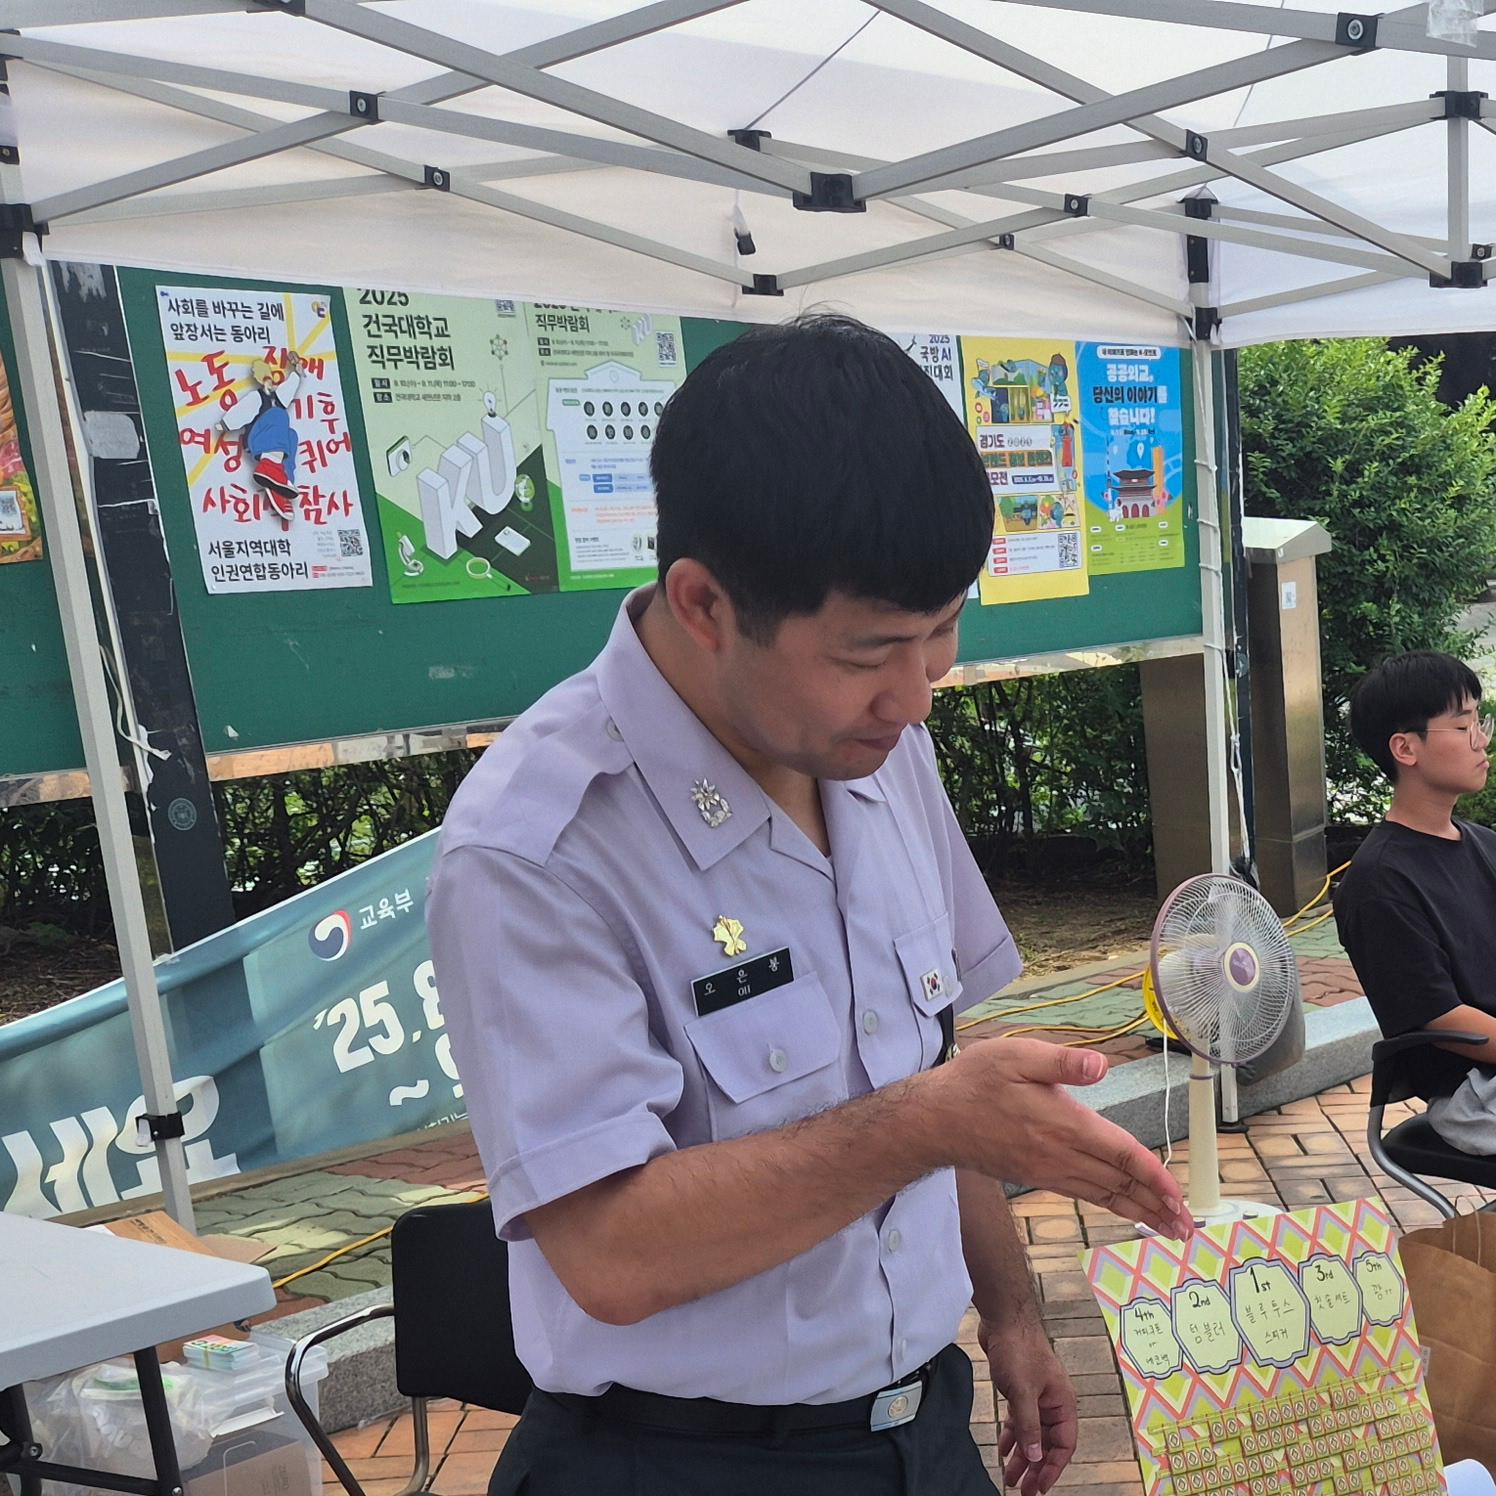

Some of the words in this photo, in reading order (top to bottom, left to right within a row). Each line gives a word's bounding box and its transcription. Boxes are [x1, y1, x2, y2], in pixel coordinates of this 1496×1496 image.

[168, 297, 209, 318] 사회를
[213, 299, 253, 320] 바꾸는
[257, 302, 285, 322] 길에
[170, 322, 227, 342] 앞장서는
[231, 324, 271, 344] 동아리
[362, 313, 451, 340] 건국대학교
[536, 313, 591, 333] 직무박람회
[367, 343, 455, 371] 직무박람회
[920, 345, 939, 363] 국방
[941, 349, 952, 362] AI
[175, 350, 239, 412] 노동
[293, 391, 340, 435] 기후
[179, 427, 244, 473] 여성
[298, 432, 353, 474] 퀴어
[987, 471, 1009, 485] 모전
[297, 484, 354, 525] 참사
[208, 538, 291, 558] 서울지역대학
[211, 561, 309, 583] 인권연합동아리
[358, 888, 414, 931] 교육부
[1250, 1266, 1271, 1293] 1st
[1315, 1264, 1335, 1282] 3rd
[1189, 1291, 1211, 1309] 2nd
[1245, 1298, 1296, 1324] 블루투스
[1135, 1307, 1155, 1322] 4th
[1189, 1322, 1225, 1345] 텀블러
[1264, 1327, 1289, 1344] 스피커
